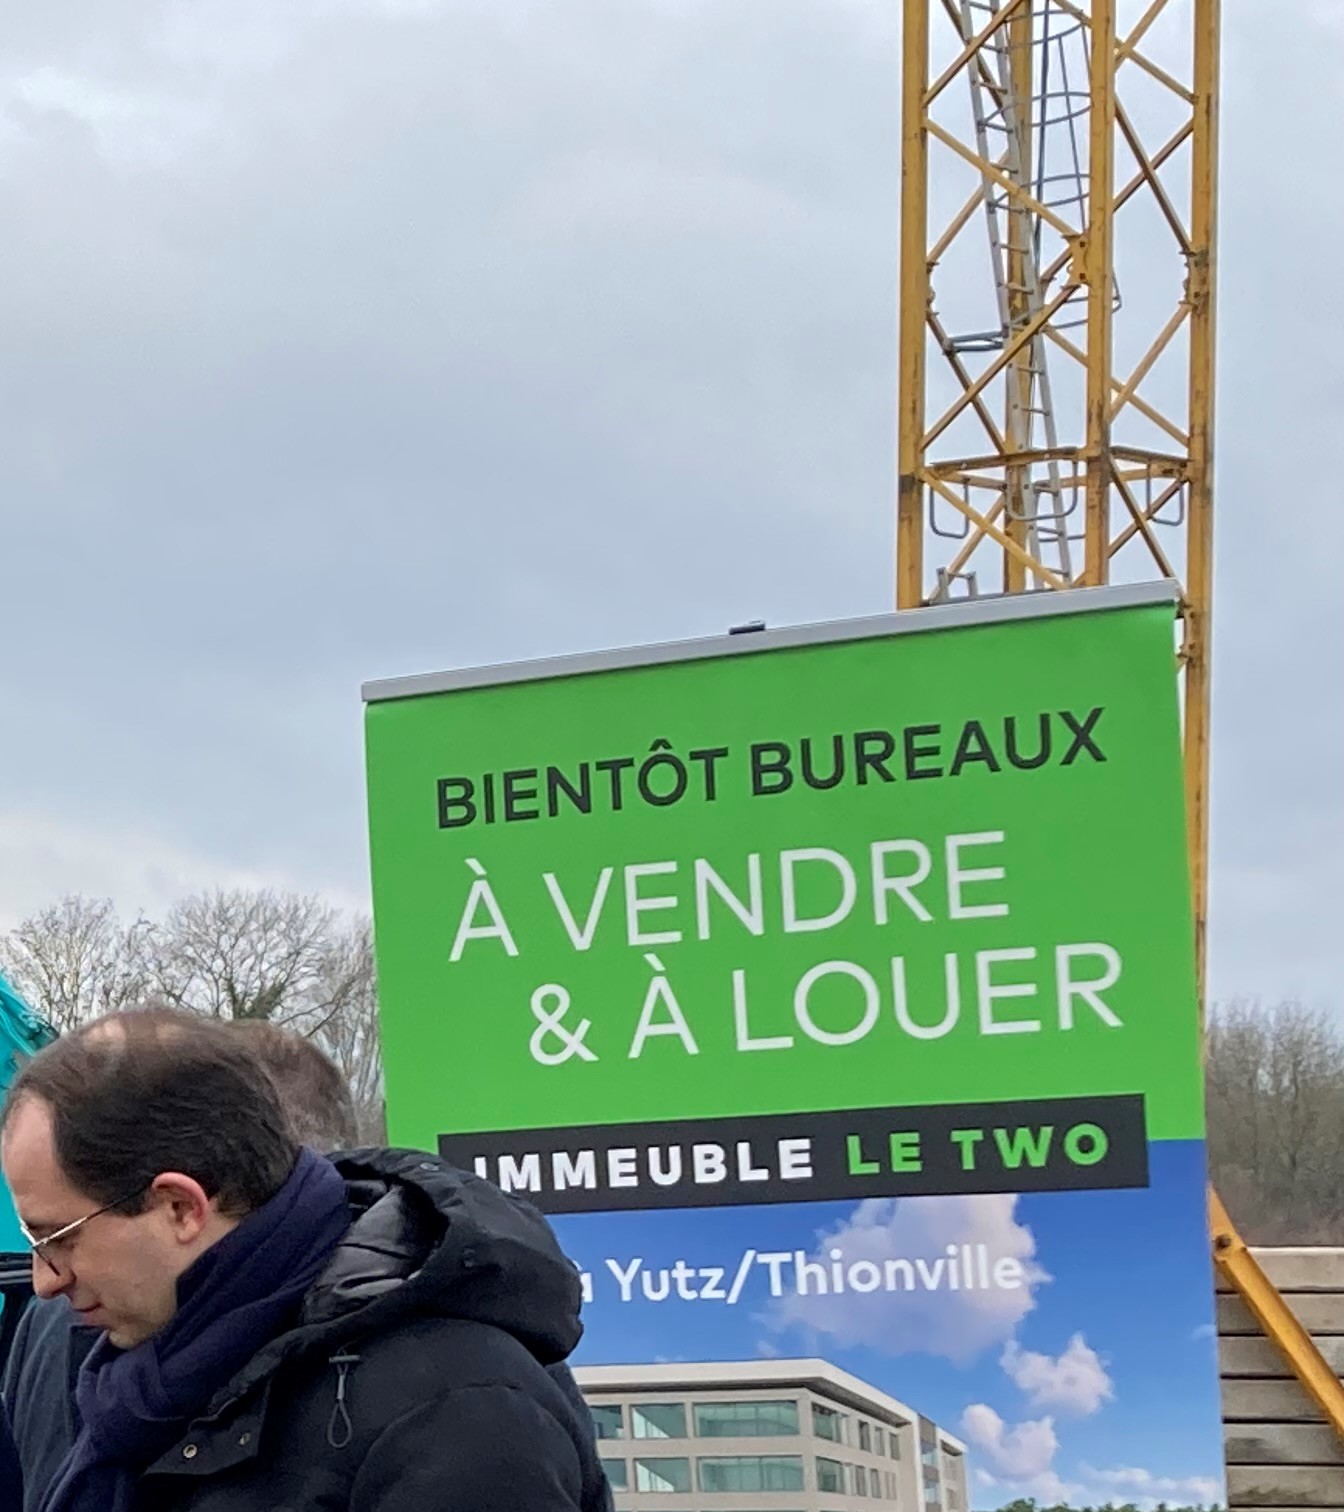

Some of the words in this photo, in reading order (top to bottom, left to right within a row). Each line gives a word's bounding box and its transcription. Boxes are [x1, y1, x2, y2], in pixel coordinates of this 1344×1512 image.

[437, 738, 728, 829] BIENTÔT
[751, 707, 1107, 797] BUREAUX
[448, 858, 519, 962] À
[543, 830, 1011, 951] VENDRE
[529, 984, 599, 1065] &
[628, 953, 700, 1059] À
[733, 942, 1124, 1052] LOUER
[847, 1131, 923, 1176] LE
[951, 1122, 1109, 1172] TWO
[605, 1243, 1024, 1304] Yutz/Thionville
